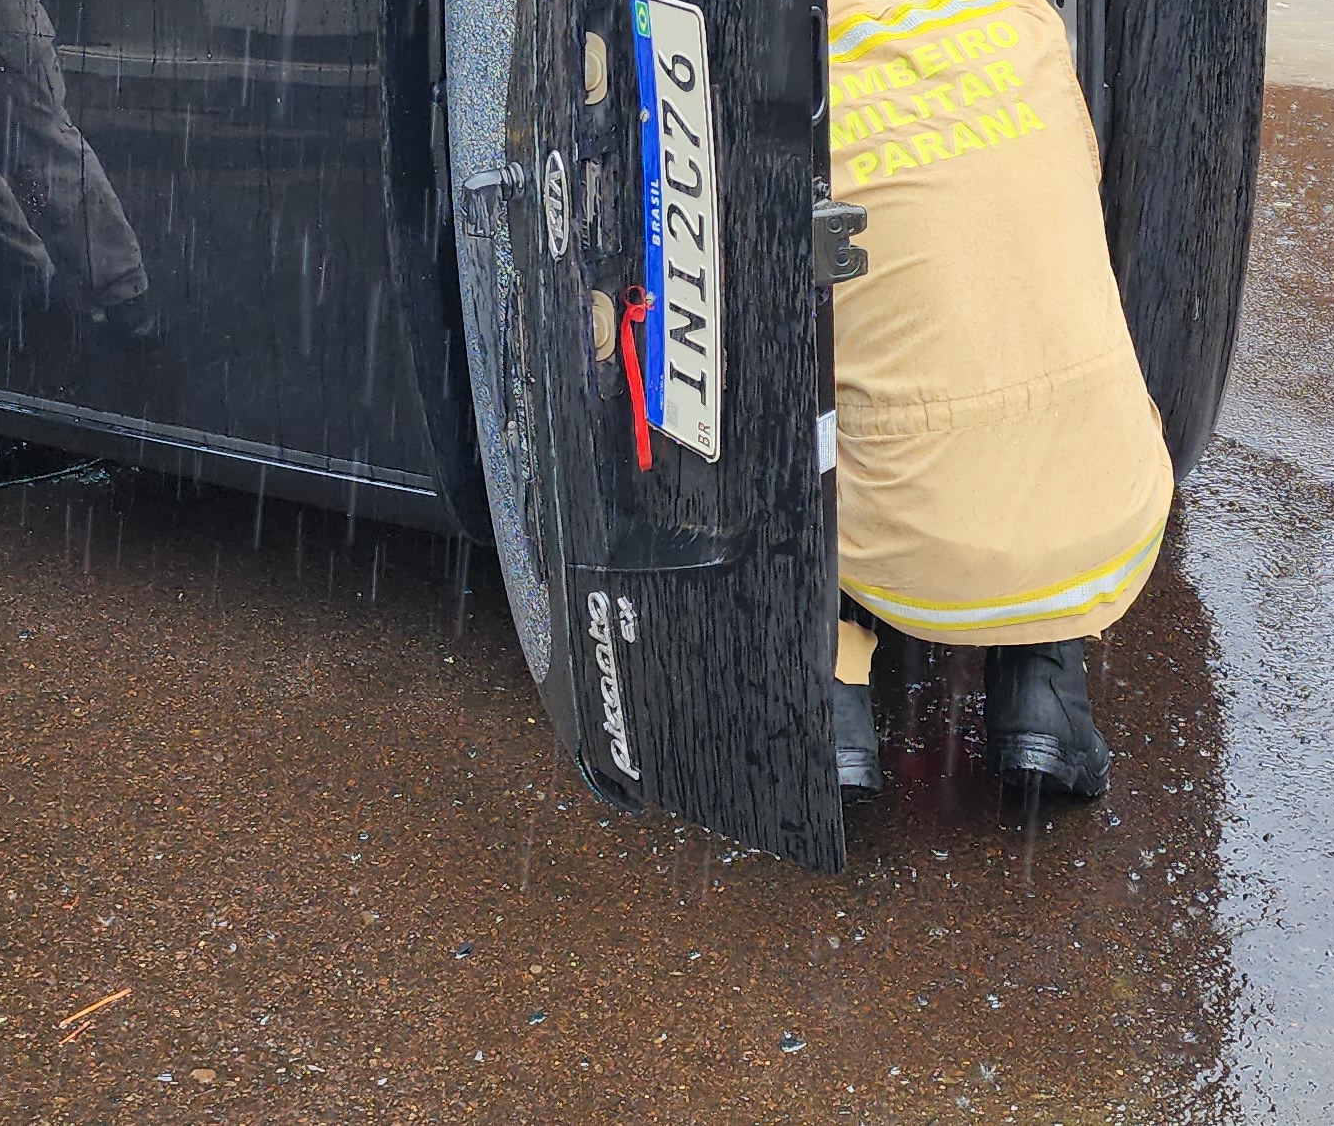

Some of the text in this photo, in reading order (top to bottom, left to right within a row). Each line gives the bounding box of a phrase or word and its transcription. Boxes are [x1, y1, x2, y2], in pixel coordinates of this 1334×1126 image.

[829, 20, 1020, 109] OMBEIRO
[829, 59, 1025, 151] MILITAR
[848, 93, 1047, 186] PARANÁ
[650, 177, 662, 247] BRASIL
[656, 51, 708, 408] INI2C76
[697, 421, 712, 450] BR
